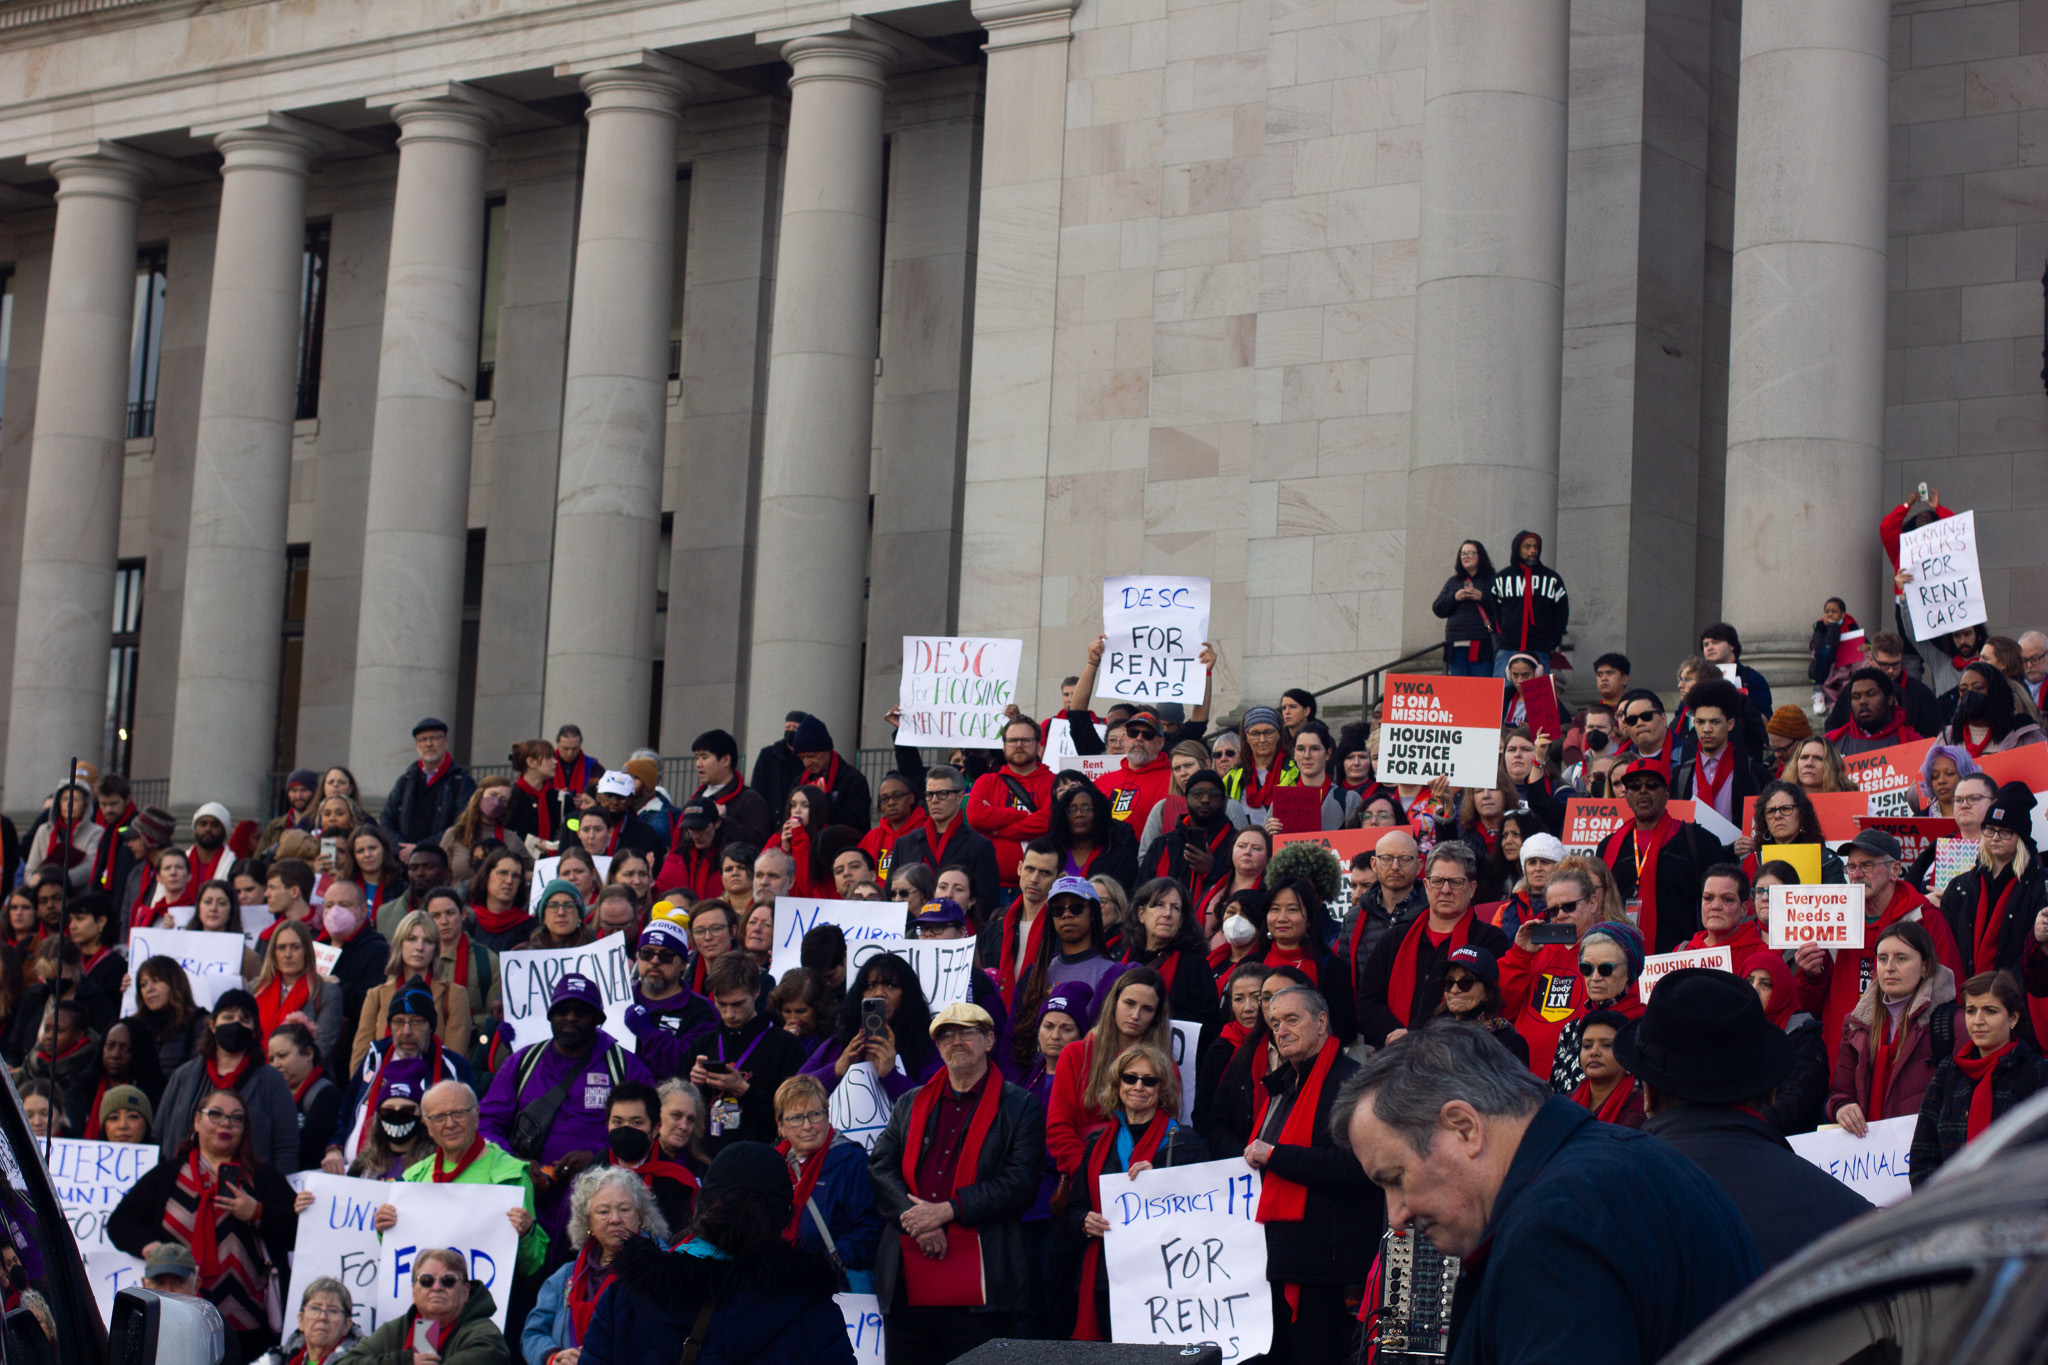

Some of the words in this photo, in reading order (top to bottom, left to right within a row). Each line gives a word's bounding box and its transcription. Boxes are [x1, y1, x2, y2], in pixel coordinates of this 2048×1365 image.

[1904, 517, 1966, 547] WORKING
[1910, 533, 1966, 564] FOLKS
[1921, 554, 1956, 580] FOR
[1121, 587, 1195, 609] DESC
[1919, 577, 1968, 606] RENT
[1926, 601, 1968, 629] CAPS
[1132, 625, 1184, 654] FOR
[913, 640, 997, 678] DESC
[1110, 652, 1195, 682] RENT
[933, 677, 1013, 706] HOUSING
[1115, 679, 1184, 697] CAPS
[1393, 682, 1434, 695] YWCA
[1391, 694, 1405, 708] IS
[1407, 695, 1428, 709] ON
[1430, 697, 1440, 709] A
[1391, 708, 1453, 724] MISSION:
[912, 711, 956, 737] RENT
[960, 712, 1006, 741] CAPS
[1389, 728, 1463, 744] HOUSING
[1387, 744, 1450, 760] JUSTICE
[1083, 760, 1103, 769] Rent
[1387, 760, 1418, 775] FOR
[1421, 762, 1455, 777] ALL!
[1848, 755, 1888, 773] YWCA
[1862, 767, 1882, 781] ON
[1885, 764, 1896, 777] A
[1860, 774, 1908, 792] ISSION:
[1116, 801, 1131, 812] IN
[1576, 806, 1619, 817] YWCA
[1573, 818, 1587, 829] IS
[1589, 818, 1612, 830] ON
[1613, 818, 1624, 830] A
[1785, 891, 1847, 908] Everyone
[1787, 908, 1830, 921] Needs
[1837, 911, 1844, 921] a
[1785, 926, 1847, 941] HOME
[1646, 959, 1695, 976] HOUSING
[1700, 955, 1723, 968] AND
[1551, 985, 1571, 993] body
[1548, 993, 1569, 1006] IN
[1115, 1189, 1220, 1226] DISTRICT
[1228, 1174, 1254, 1220] 17
[341, 1251, 381, 1287] FO
[394, 1246, 496, 1298] FD
[1161, 1237, 1231, 1289] FOR
[1144, 1292, 1250, 1334] RENT
